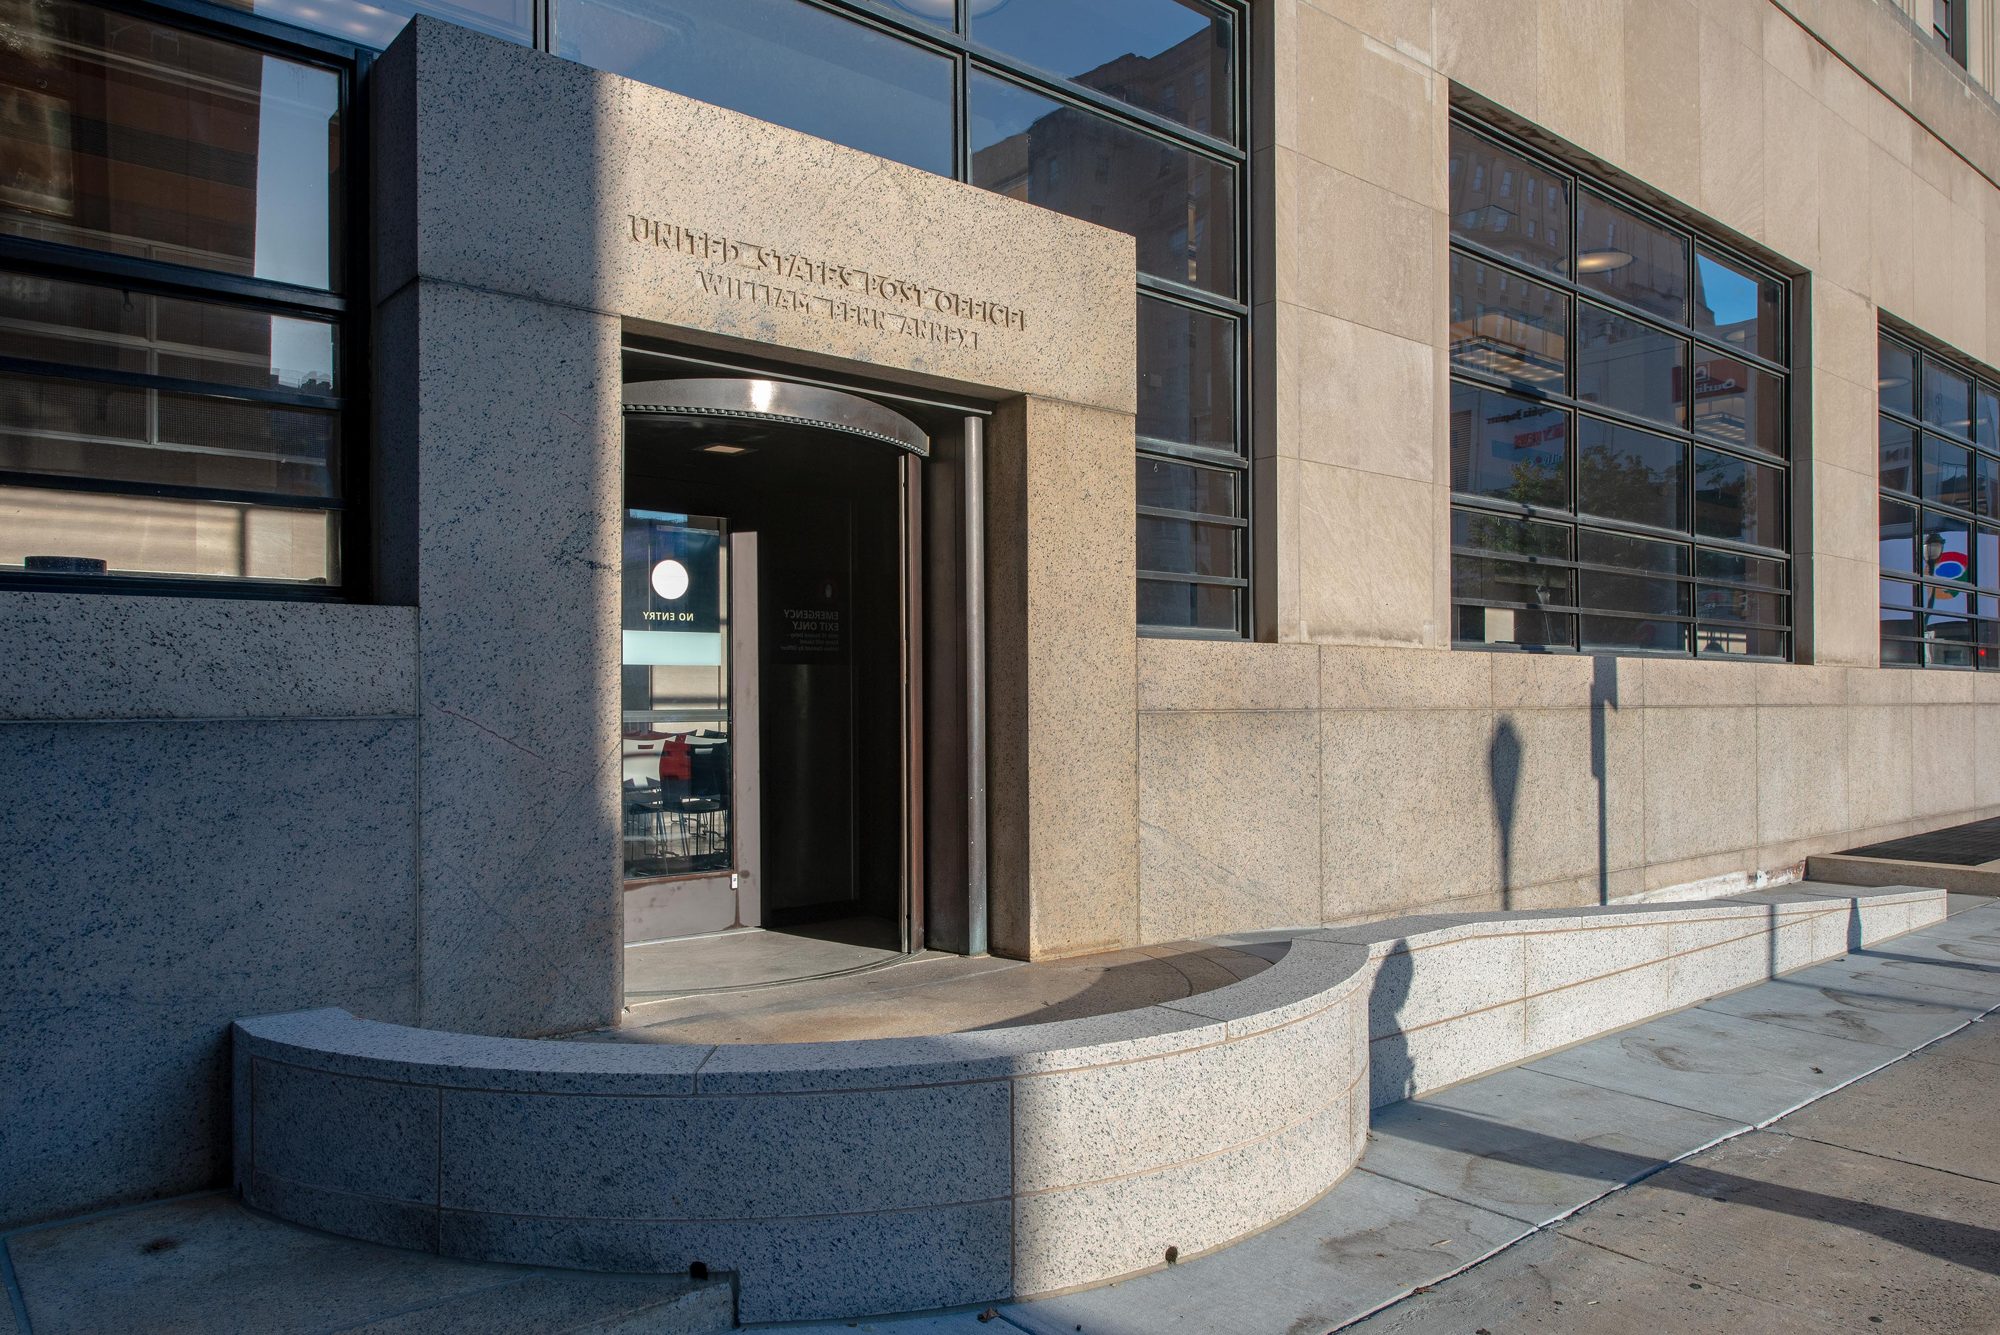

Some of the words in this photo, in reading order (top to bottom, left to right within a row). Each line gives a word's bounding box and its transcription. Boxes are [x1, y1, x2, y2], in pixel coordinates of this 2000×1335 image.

[629, 214, 741, 265] UNITED
[757, 246, 851, 288] STATES
[865, 272, 926, 309] POST
[936, 289, 1023, 331] OFFICE
[696, 270, 811, 314] WILLIAM
[829, 300, 889, 330] PENN
[899, 315, 977, 350] ANNEX
